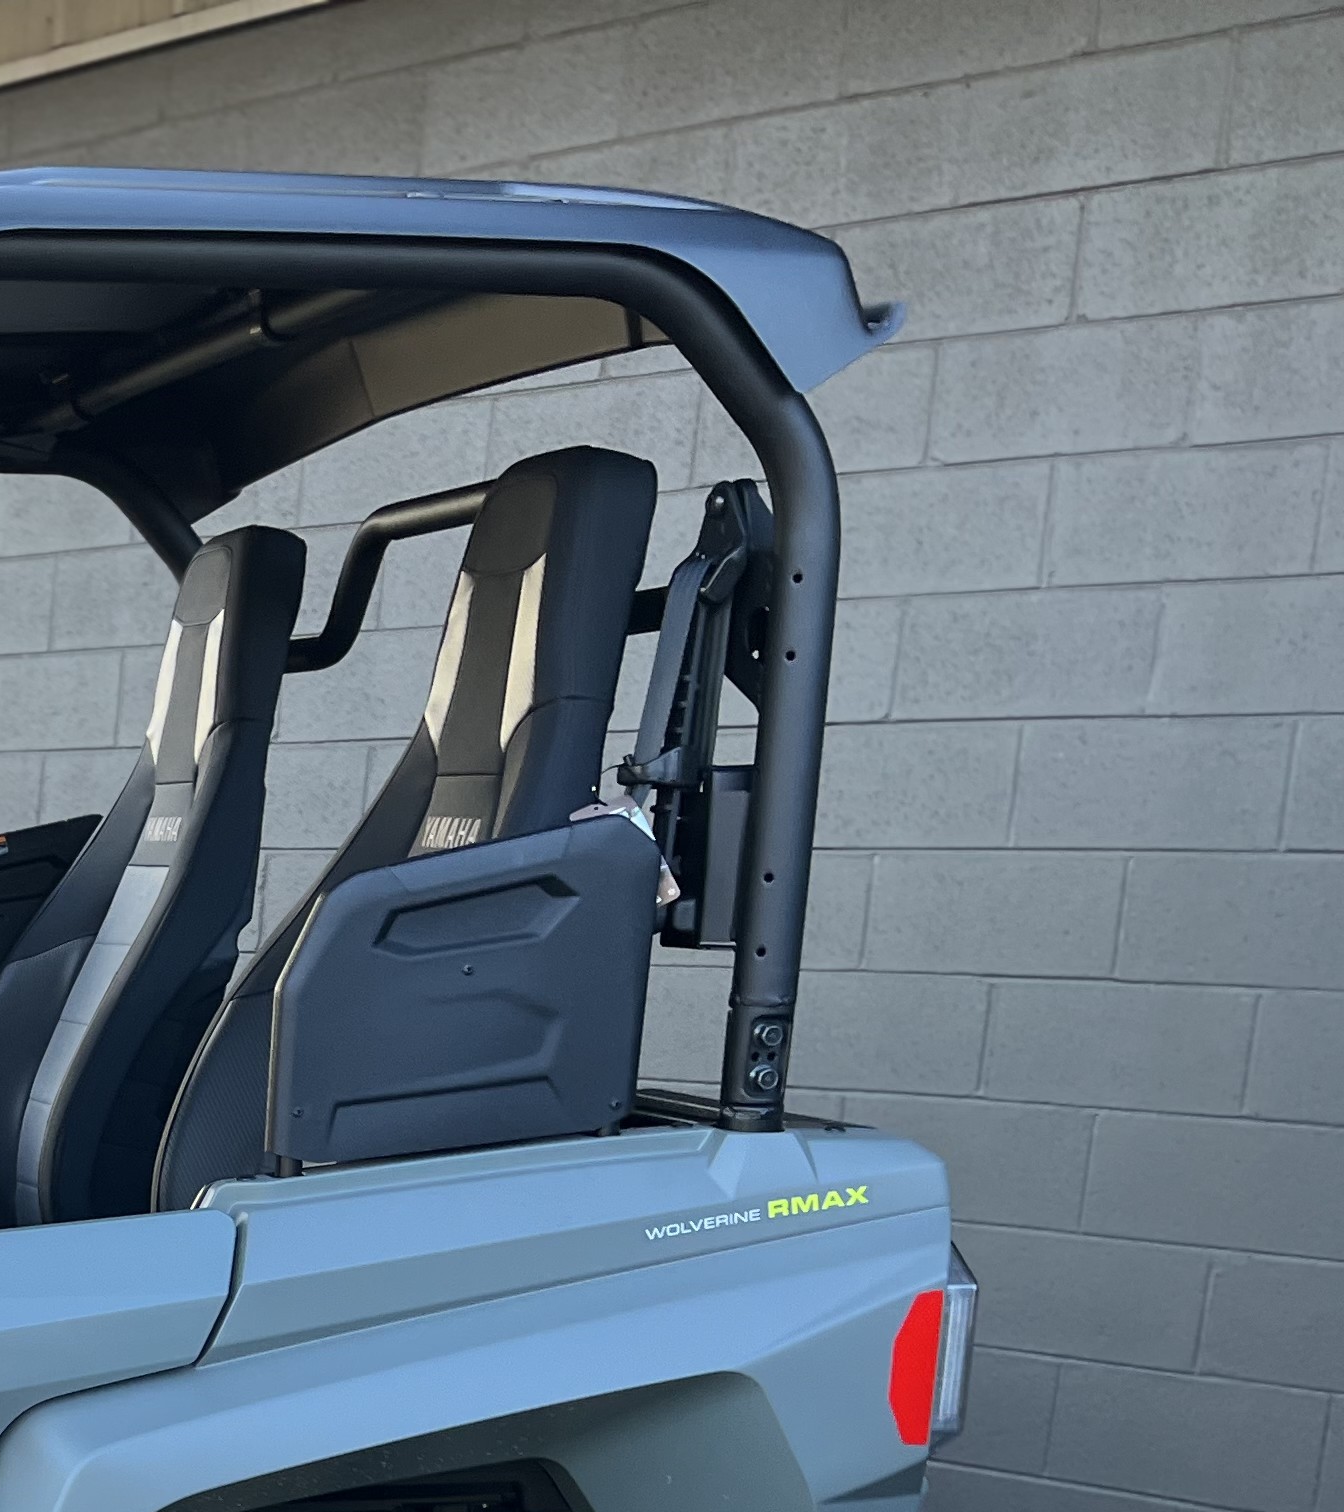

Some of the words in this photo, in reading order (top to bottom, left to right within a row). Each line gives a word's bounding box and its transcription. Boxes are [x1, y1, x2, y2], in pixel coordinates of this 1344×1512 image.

[422, 816, 481, 849] YAMAHA
[645, 1208, 761, 1241] WOLVERINE
[767, 1185, 869, 1218] RMAX
